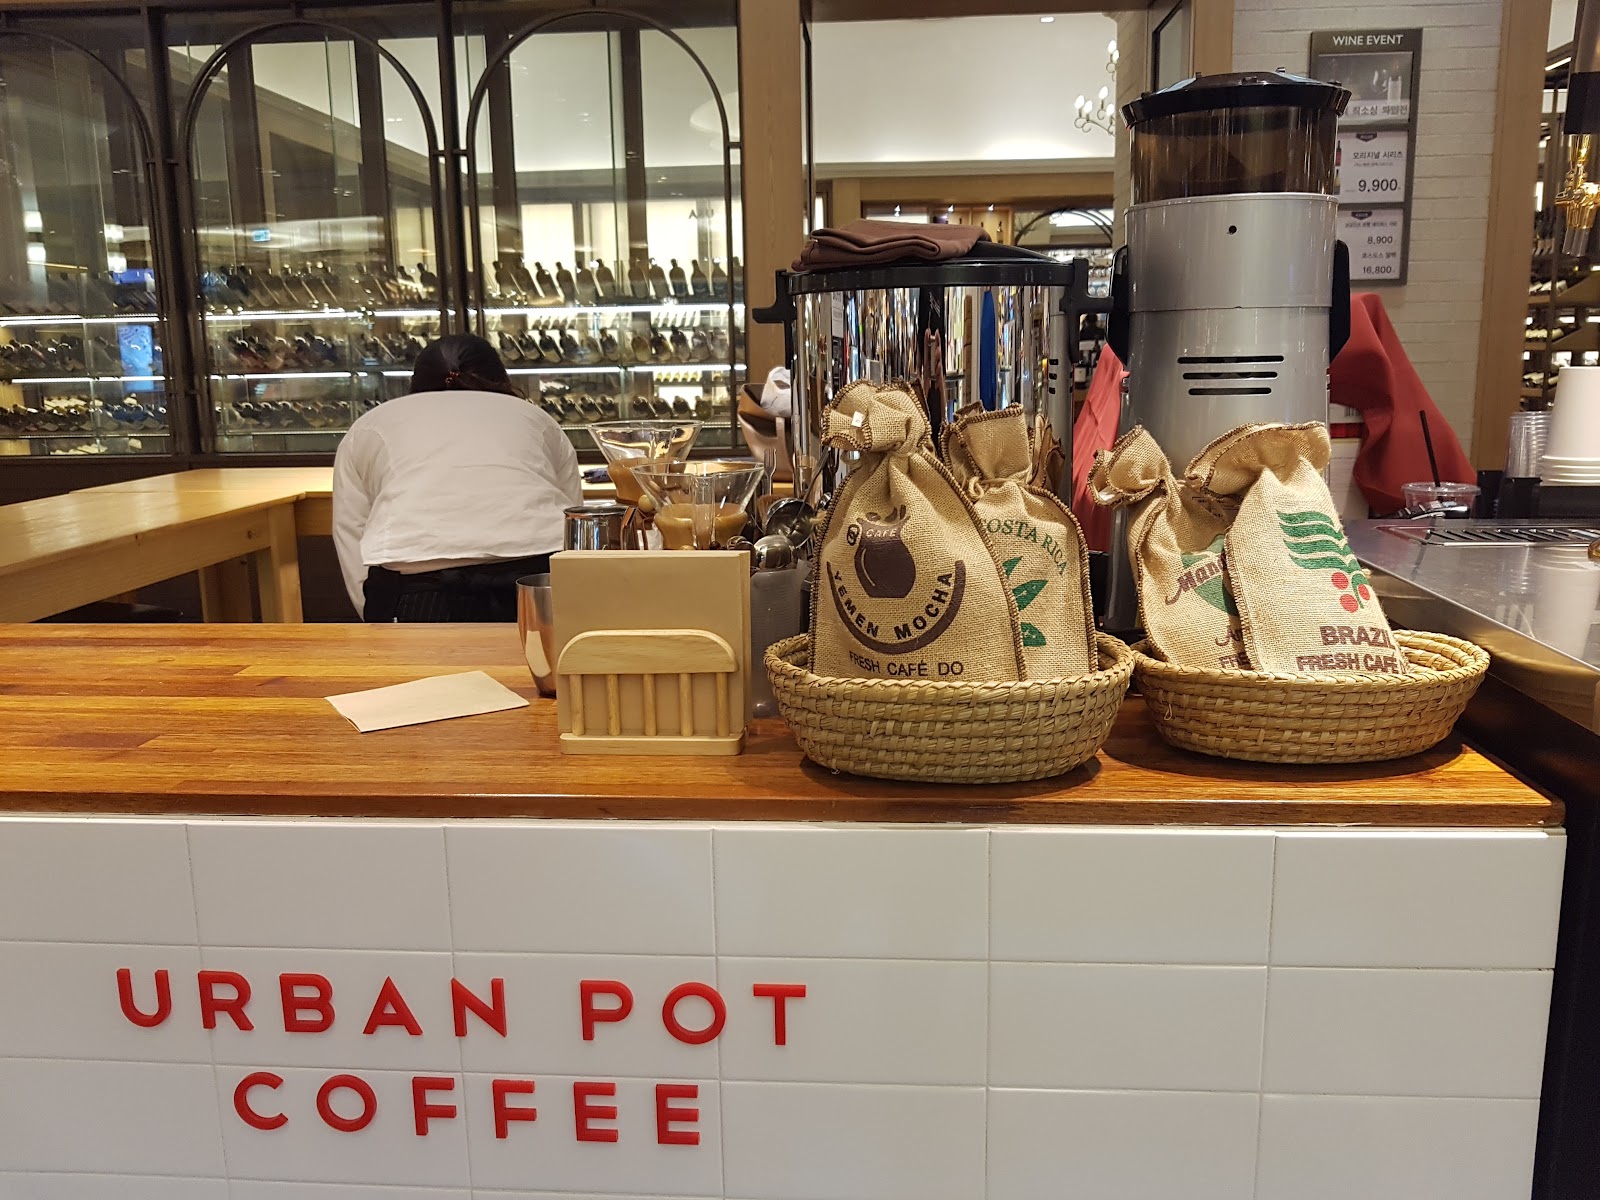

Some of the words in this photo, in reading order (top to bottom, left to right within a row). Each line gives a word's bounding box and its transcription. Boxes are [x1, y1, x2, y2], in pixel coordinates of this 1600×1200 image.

[1332, 35, 1363, 46] WINE
[1366, 35, 1403, 45] EVENT
[1040, 532, 1067, 576] RICA
[833, 570, 880, 638] YEMEN
[893, 572, 953, 641] MOCHA
[849, 651, 880, 673] FRESH
[886, 660, 929, 677] CAFÉ
[937, 660, 964, 676] DO
[1297, 652, 1360, 672] FRESH
[116, 967, 508, 1037] URBAN
[579, 979, 807, 1047] POT
[233, 1071, 701, 1146] COFFEE
